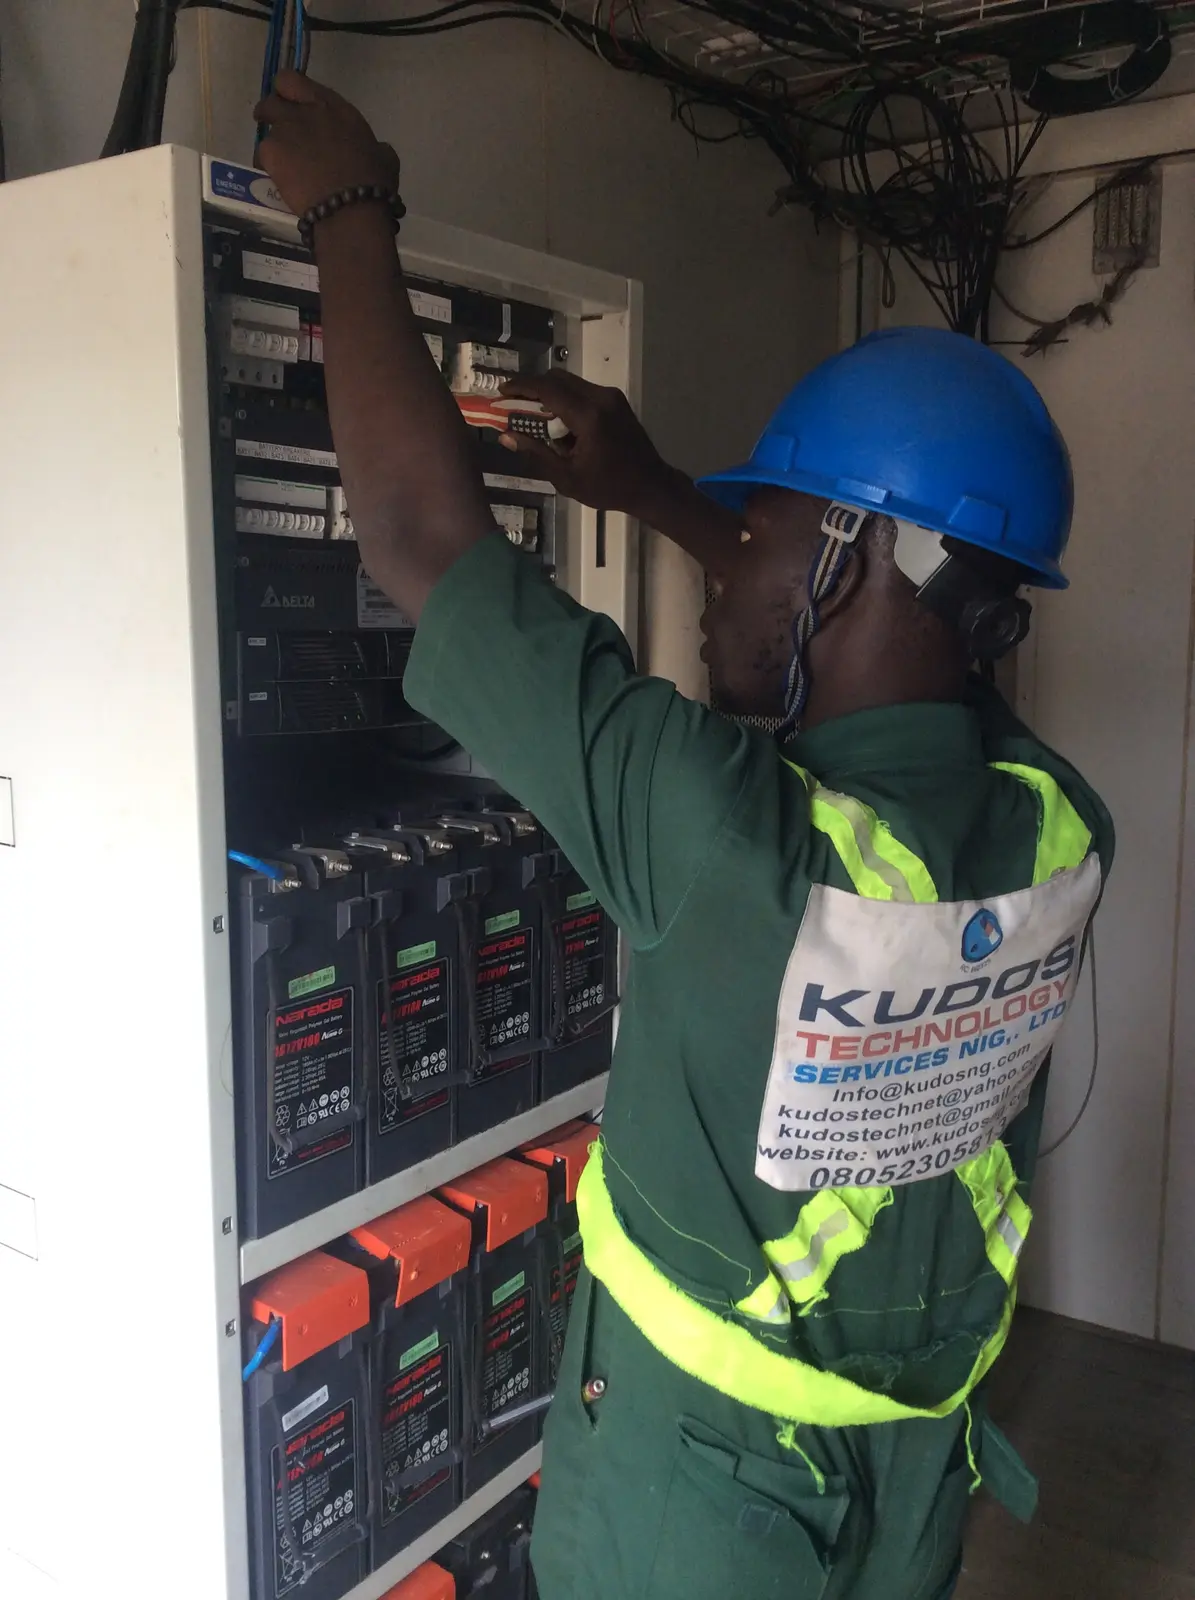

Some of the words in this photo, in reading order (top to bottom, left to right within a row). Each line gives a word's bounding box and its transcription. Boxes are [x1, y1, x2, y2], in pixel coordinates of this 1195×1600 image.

[282, 595, 316, 609] DELTA
[799, 934, 1075, 1028] KUDOS
[793, 1047, 950, 1085] SERVICES
[1028, 1000, 1067, 1033] LTD
[797, 974, 1070, 1061] TECHNOLOGY
[832, 1044, 1031, 1103] Info@kudosng.com
[758, 1145, 868, 1162] website:
